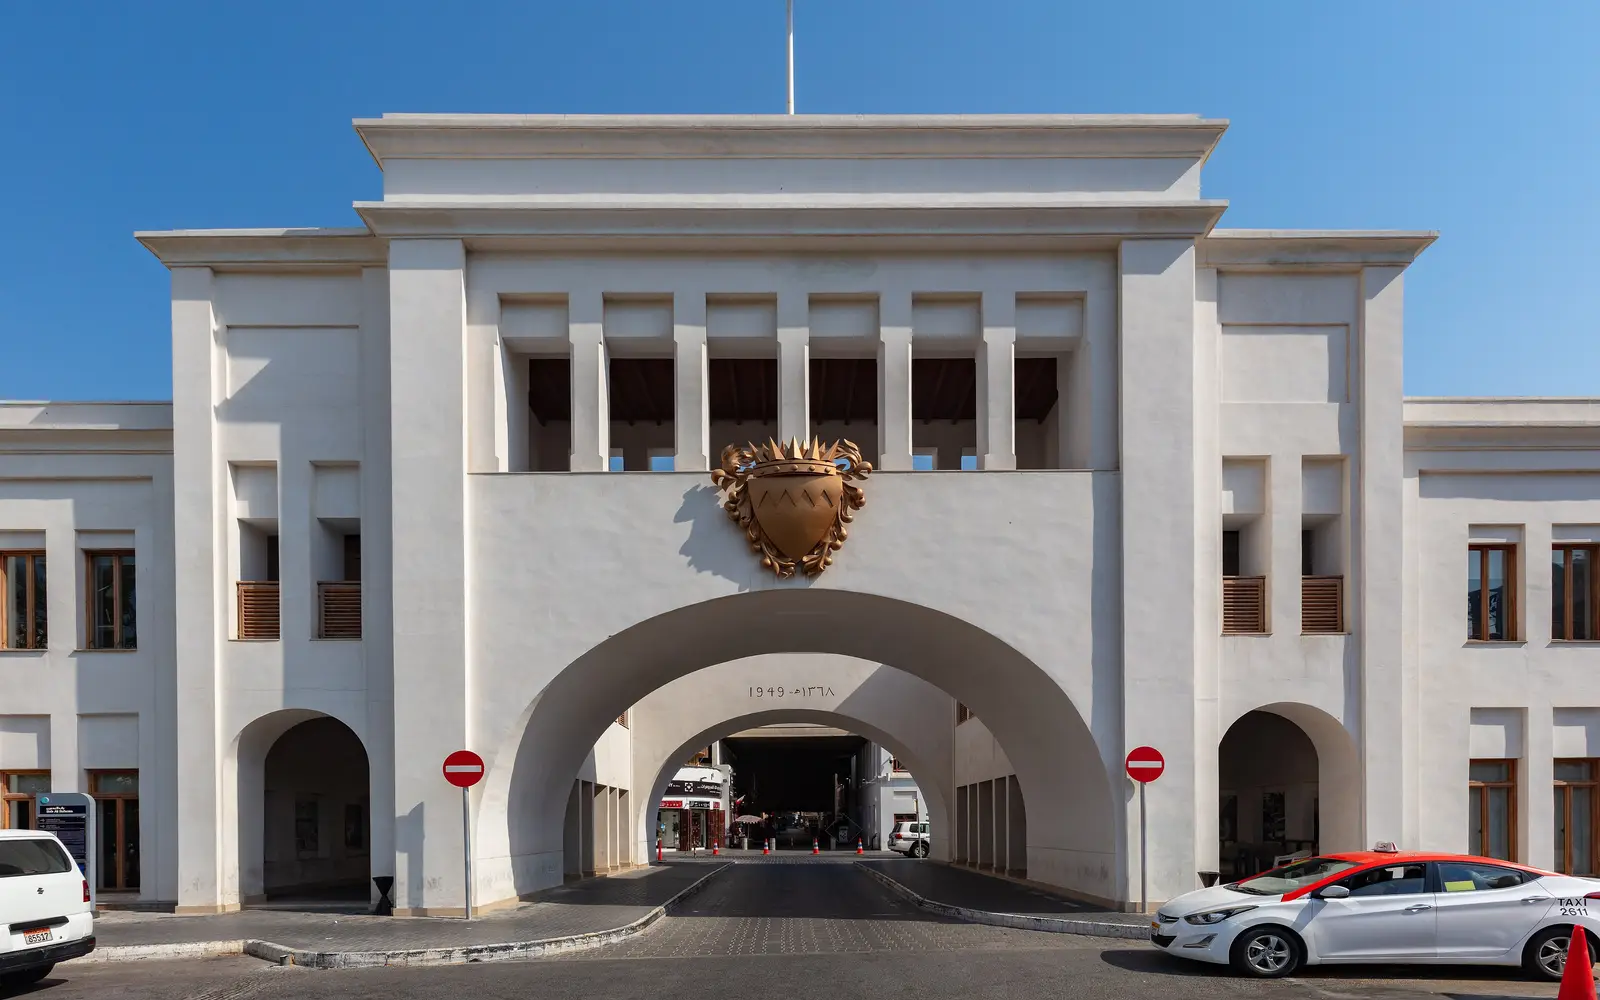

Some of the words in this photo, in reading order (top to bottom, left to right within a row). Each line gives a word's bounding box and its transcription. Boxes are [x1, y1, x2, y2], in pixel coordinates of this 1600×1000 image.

[749, 686, 785, 698] 1949
[1558, 898, 1587, 906] TAXI
[1560, 908, 1588, 916] 2611
[28, 932, 49, 943] 85517
